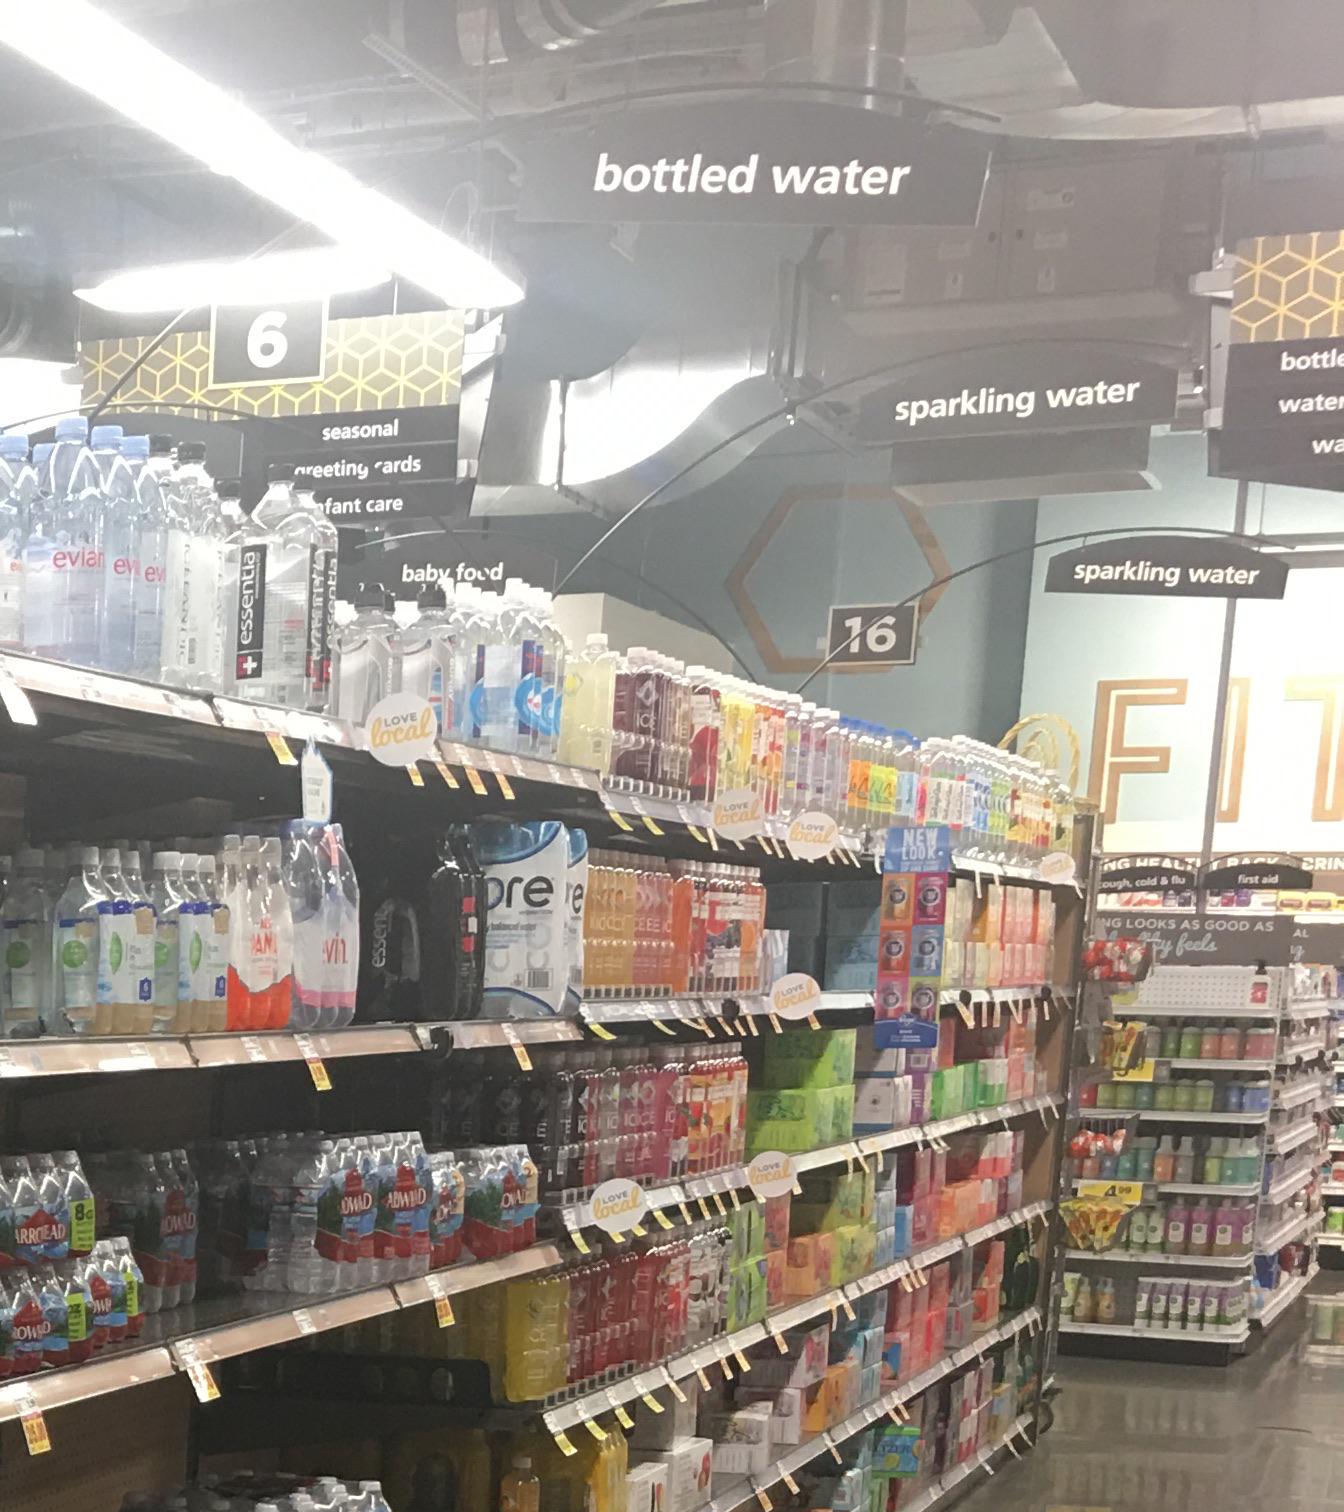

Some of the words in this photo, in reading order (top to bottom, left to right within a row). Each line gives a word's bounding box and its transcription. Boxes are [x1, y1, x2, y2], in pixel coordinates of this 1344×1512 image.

[593, 153, 758, 194] bottled
[773, 158, 911, 196] water
[247, 311, 290, 369] 6
[895, 388, 1036, 424] sparkling
[1047, 379, 1141, 410] water
[322, 418, 400, 441] seasonal
[313, 493, 361, 515] nfant
[365, 495, 404, 513] care
[402, 563, 450, 584] baby
[456, 562, 504, 581] food
[1074, 561, 1181, 587] sparkling
[1188, 563, 1259, 586] water
[239, 550, 256, 646] essentia
[843, 615, 897, 654] 16
[370, 706, 433, 749] local
[383, 712, 418, 728] LOVE
[715, 800, 761, 828] local
[724, 803, 751, 813] LOVE
[790, 826, 834, 846] local
[801, 824, 826, 834] LOVE
[903, 828, 939, 846] NEW
[902, 846, 937, 861] LOOK
[1238, 874, 1260, 885] first
[1261, 874, 1280, 885] aid
[1126, 918, 1176, 930] LOOKS
[1179, 919, 1201, 930] AS
[1204, 920, 1250, 932] GOOD
[1253, 921, 1275, 932] AS
[781, 984, 804, 997] LOVE
[602, 1191, 629, 1203] LOVE
